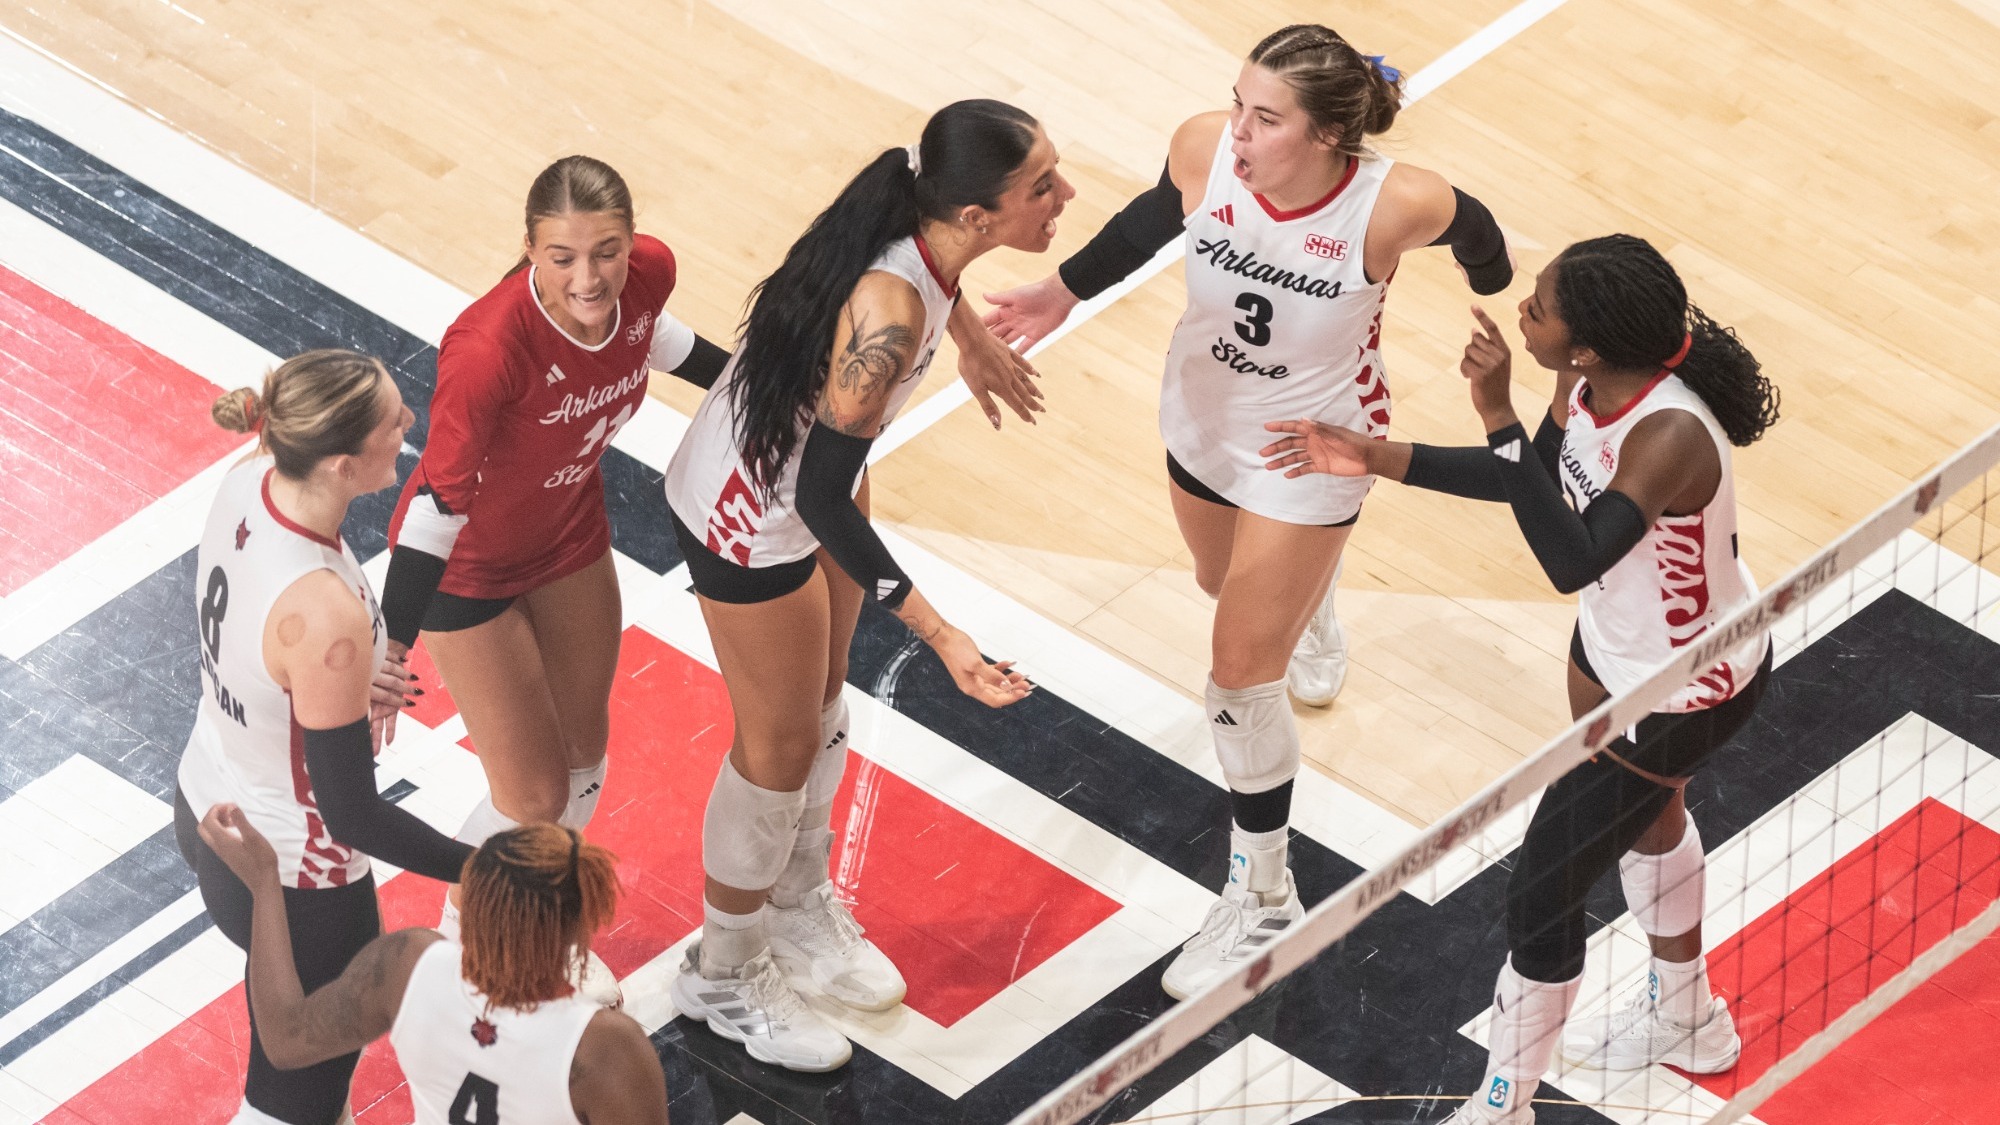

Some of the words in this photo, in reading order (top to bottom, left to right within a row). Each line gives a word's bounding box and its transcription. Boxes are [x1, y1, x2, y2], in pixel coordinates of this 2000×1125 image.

[1196, 239, 1346, 299] Arkansas
[1304, 233, 1348, 261] SBC
[1234, 292, 1273, 347] 3
[539, 352, 650, 424] Arkansa
[576, 403, 632, 458] 11
[201, 565, 229, 665] 8
